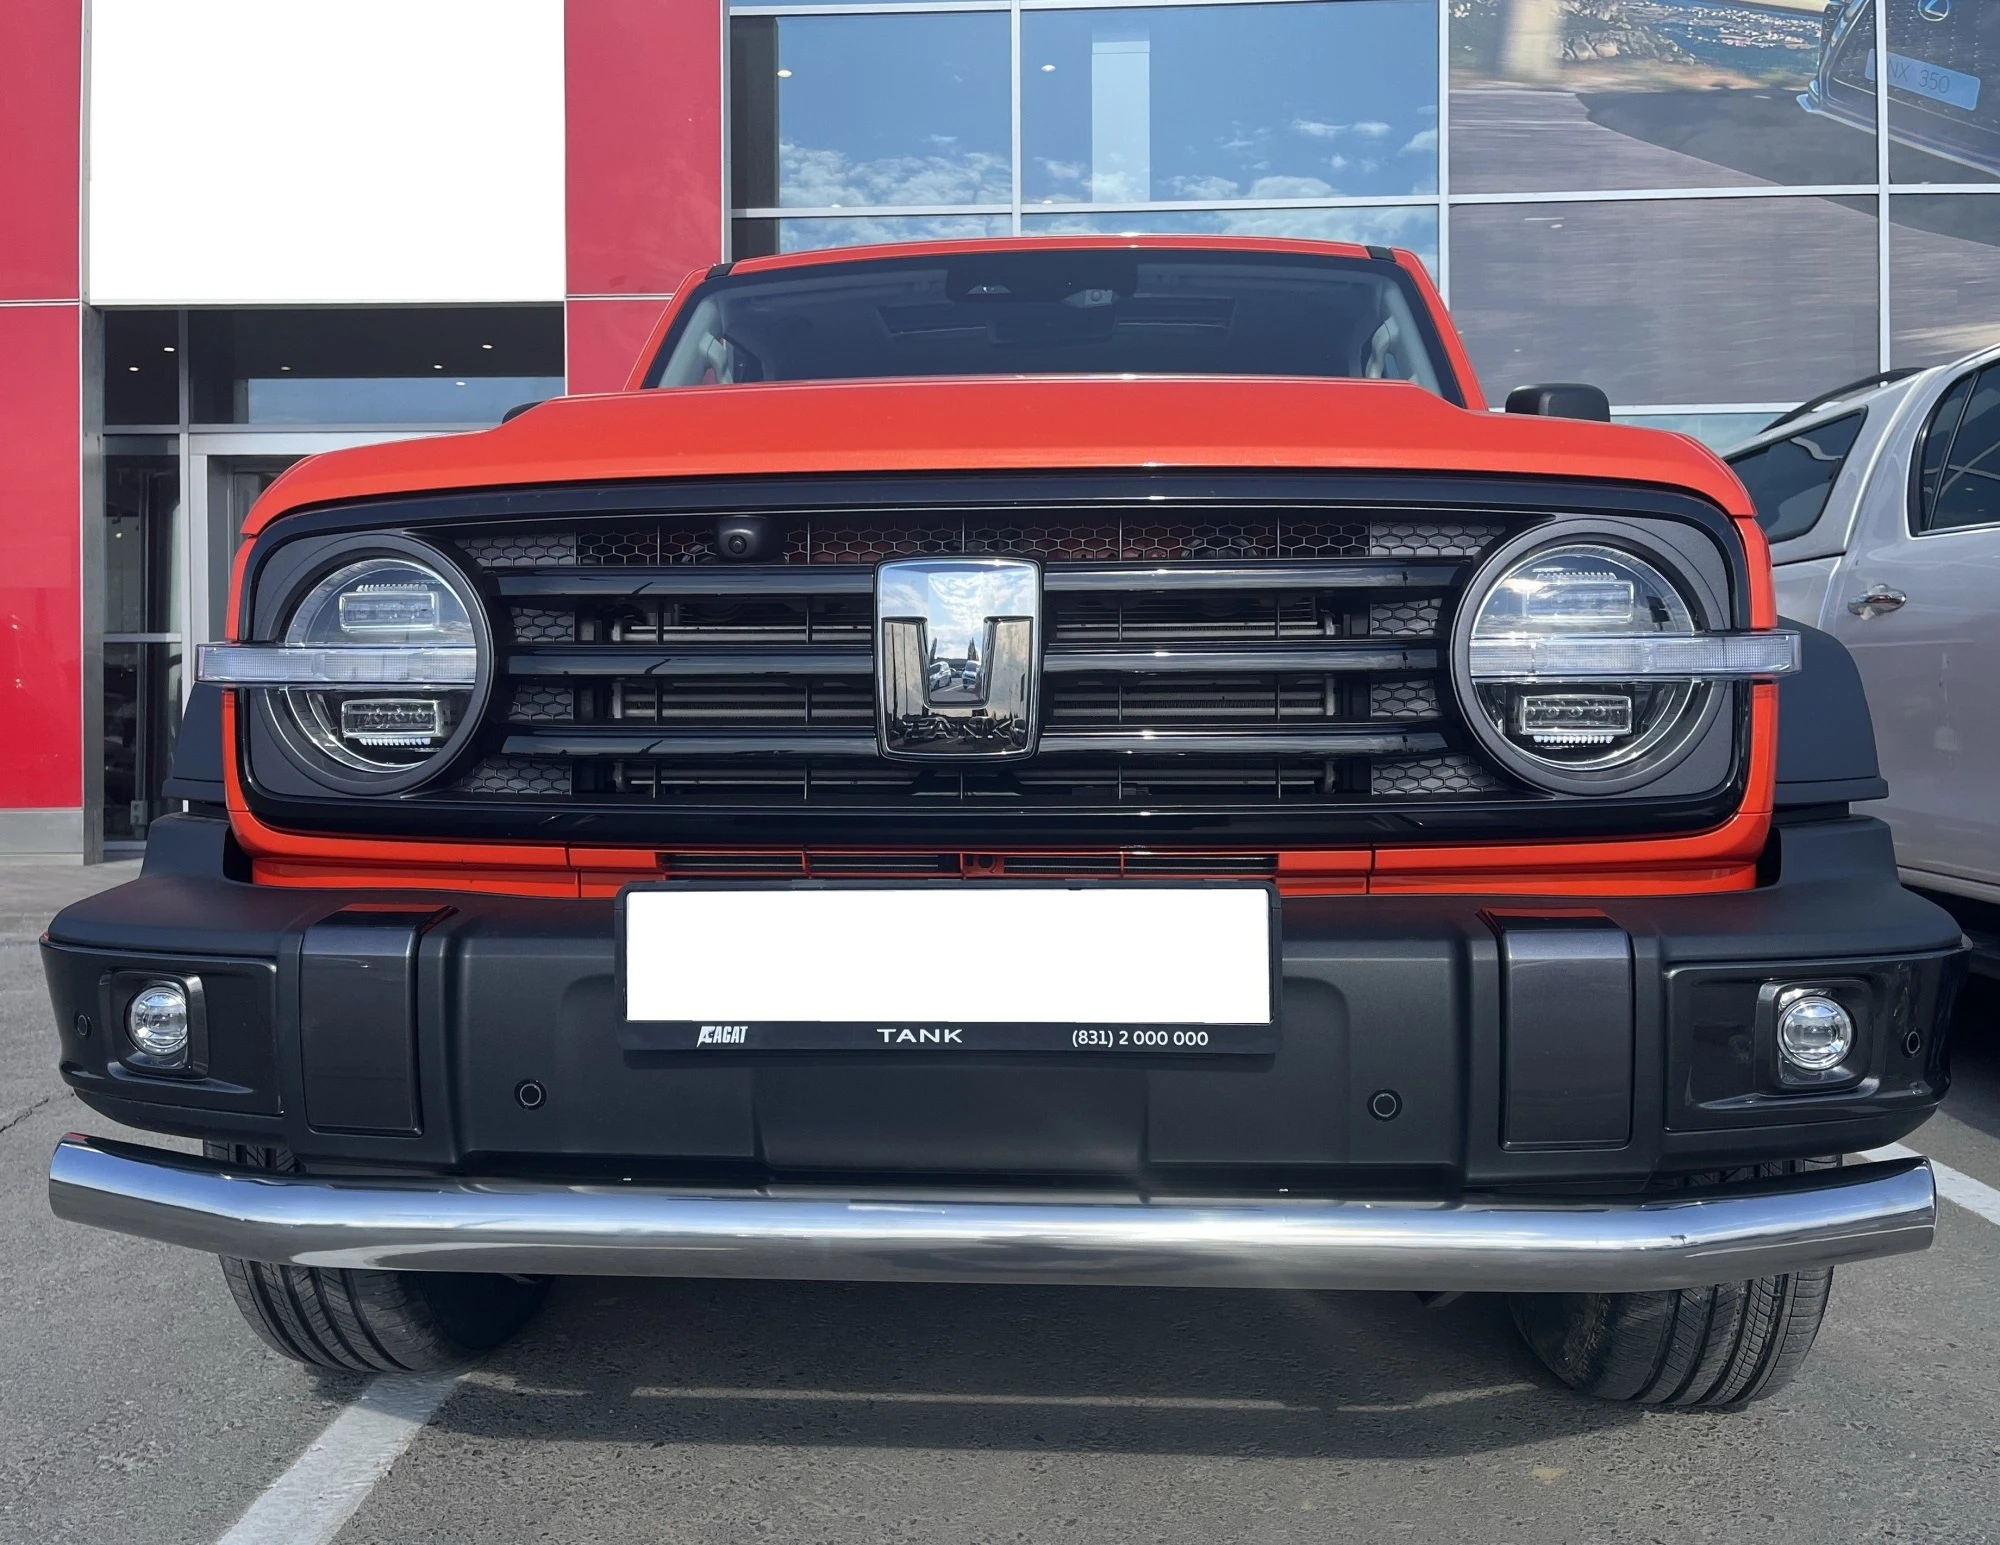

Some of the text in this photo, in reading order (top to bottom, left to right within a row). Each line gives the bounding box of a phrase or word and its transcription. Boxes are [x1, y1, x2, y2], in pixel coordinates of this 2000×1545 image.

[1918, 69, 1950, 94] 350
[876, 1028, 963, 1043] TANK
[1072, 1030, 1209, 1048] (831) 2 000 000
